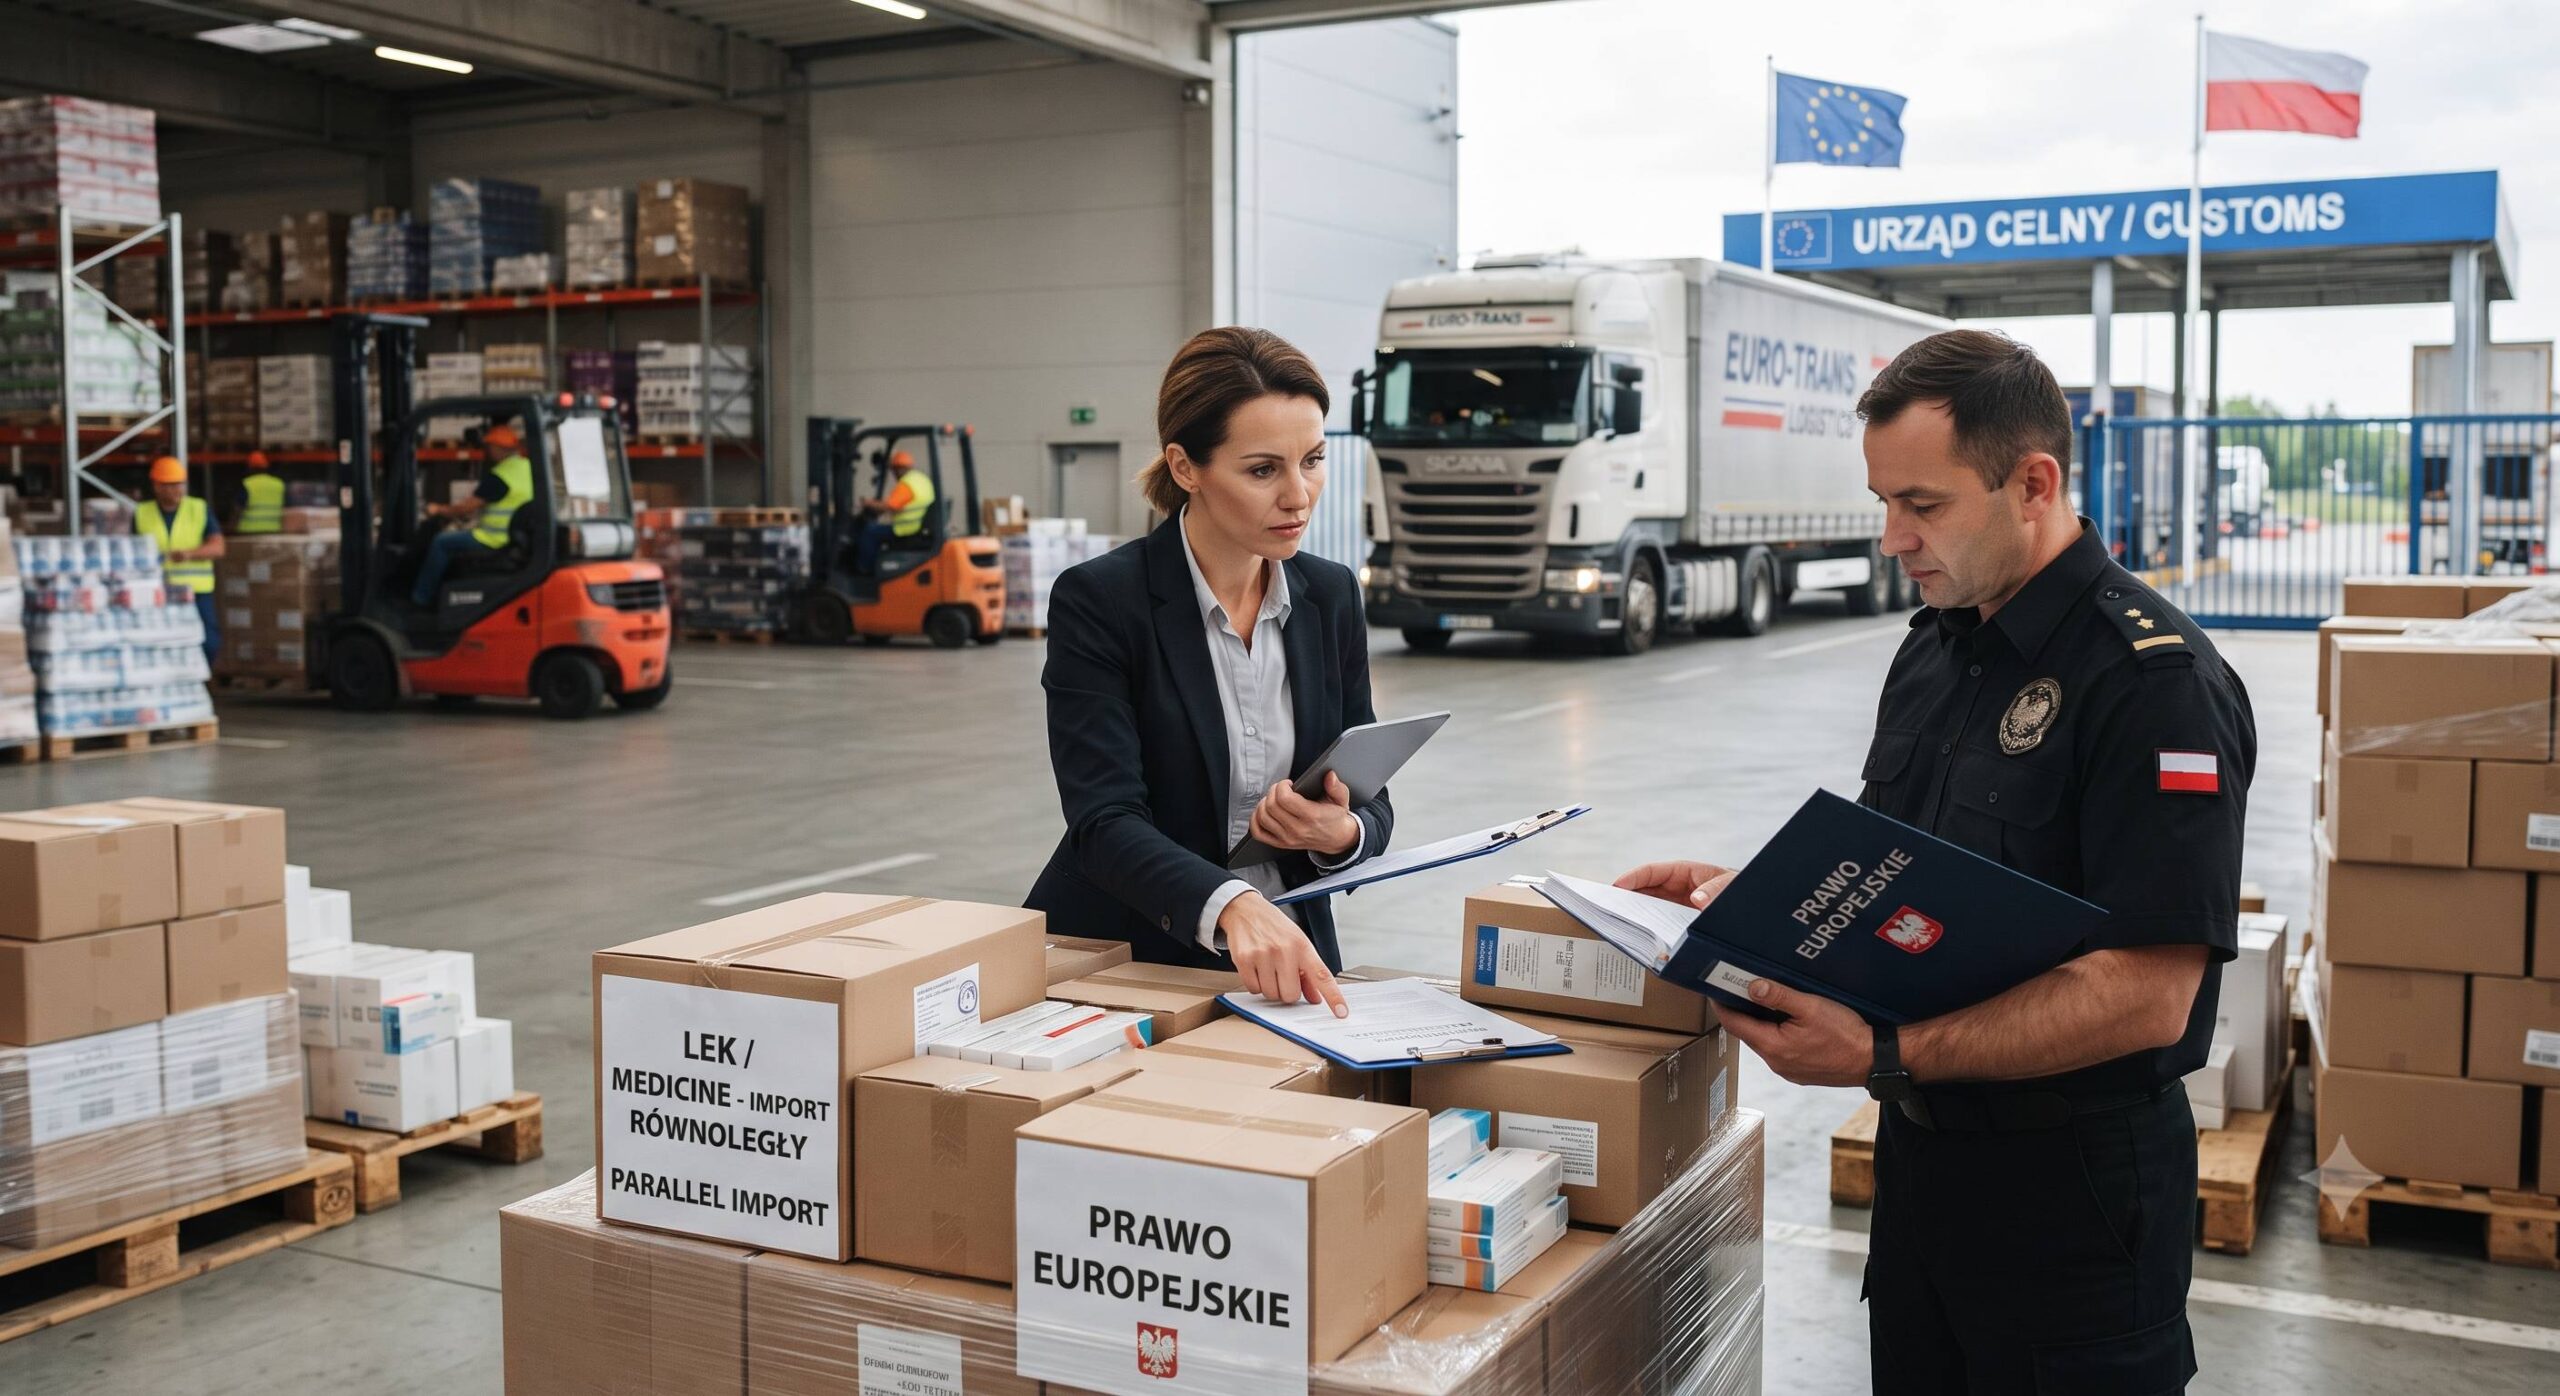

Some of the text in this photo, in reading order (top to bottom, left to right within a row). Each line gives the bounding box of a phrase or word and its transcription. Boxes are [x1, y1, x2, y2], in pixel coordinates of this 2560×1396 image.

[1853, 191, 2346, 258] URZĄD CELNY / CUSTOMS
[1725, 332, 1856, 396] EURO-TRANS
[1426, 456, 1508, 474] SCANIA
[1792, 860, 1861, 925] PRAWO
[1795, 848, 1913, 960] EUROPEJSKIE
[684, 1030, 755, 1069] LEK /
[611, 1066, 731, 1108] MEDICINE
[749, 1091, 831, 1122] IMPORT
[630, 1107, 808, 1161] RÓWNOLEGŁY
[611, 1167, 830, 1227] PARALLEL IMPORT
[1089, 1204, 1232, 1260] PRAWO
[1034, 1250, 1290, 1328] EUROPEJSKIE
